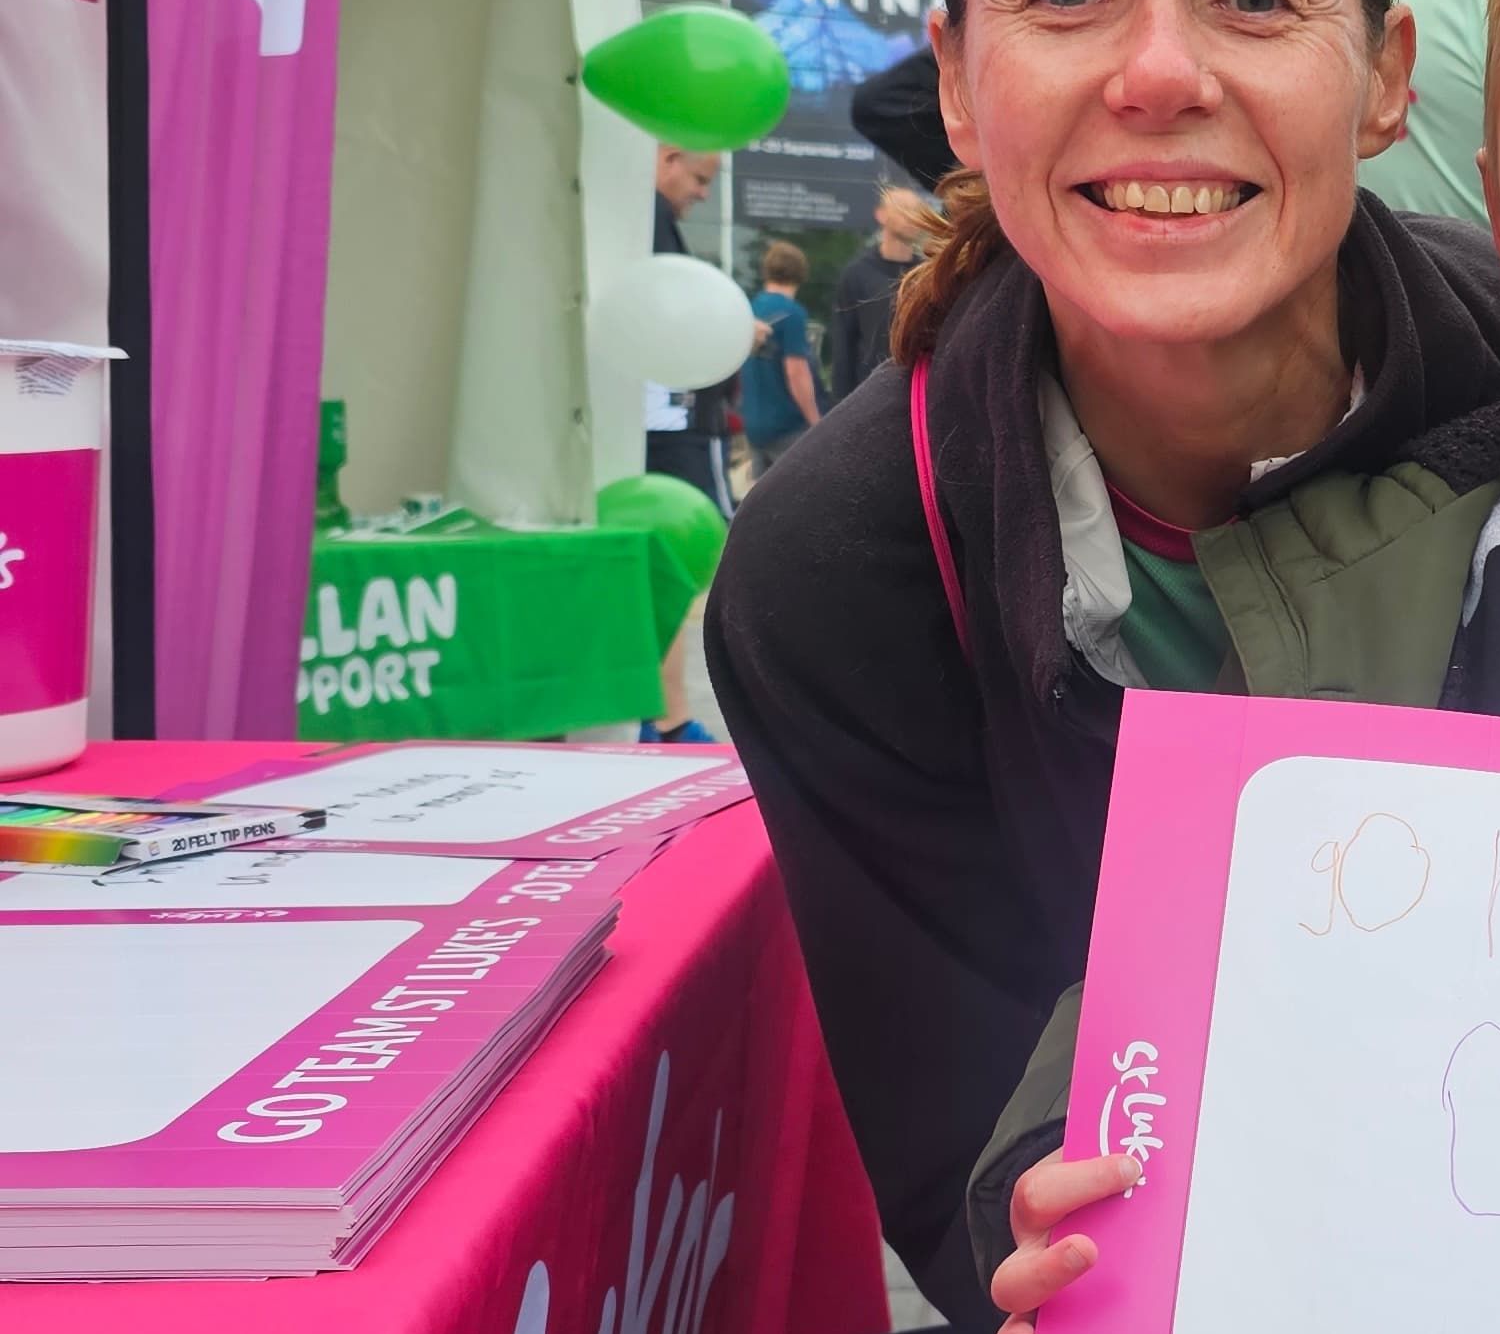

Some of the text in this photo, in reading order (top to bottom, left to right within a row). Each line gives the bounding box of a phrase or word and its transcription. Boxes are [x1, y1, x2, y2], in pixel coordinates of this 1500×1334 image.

[172, 821, 276, 853] 20 FELT TIP PENS
[546, 824, 623, 844] GO
[216, 916, 542, 1144] GO TEAM ST LUKE'S
[1120, 1092, 1168, 1199] Luk'
